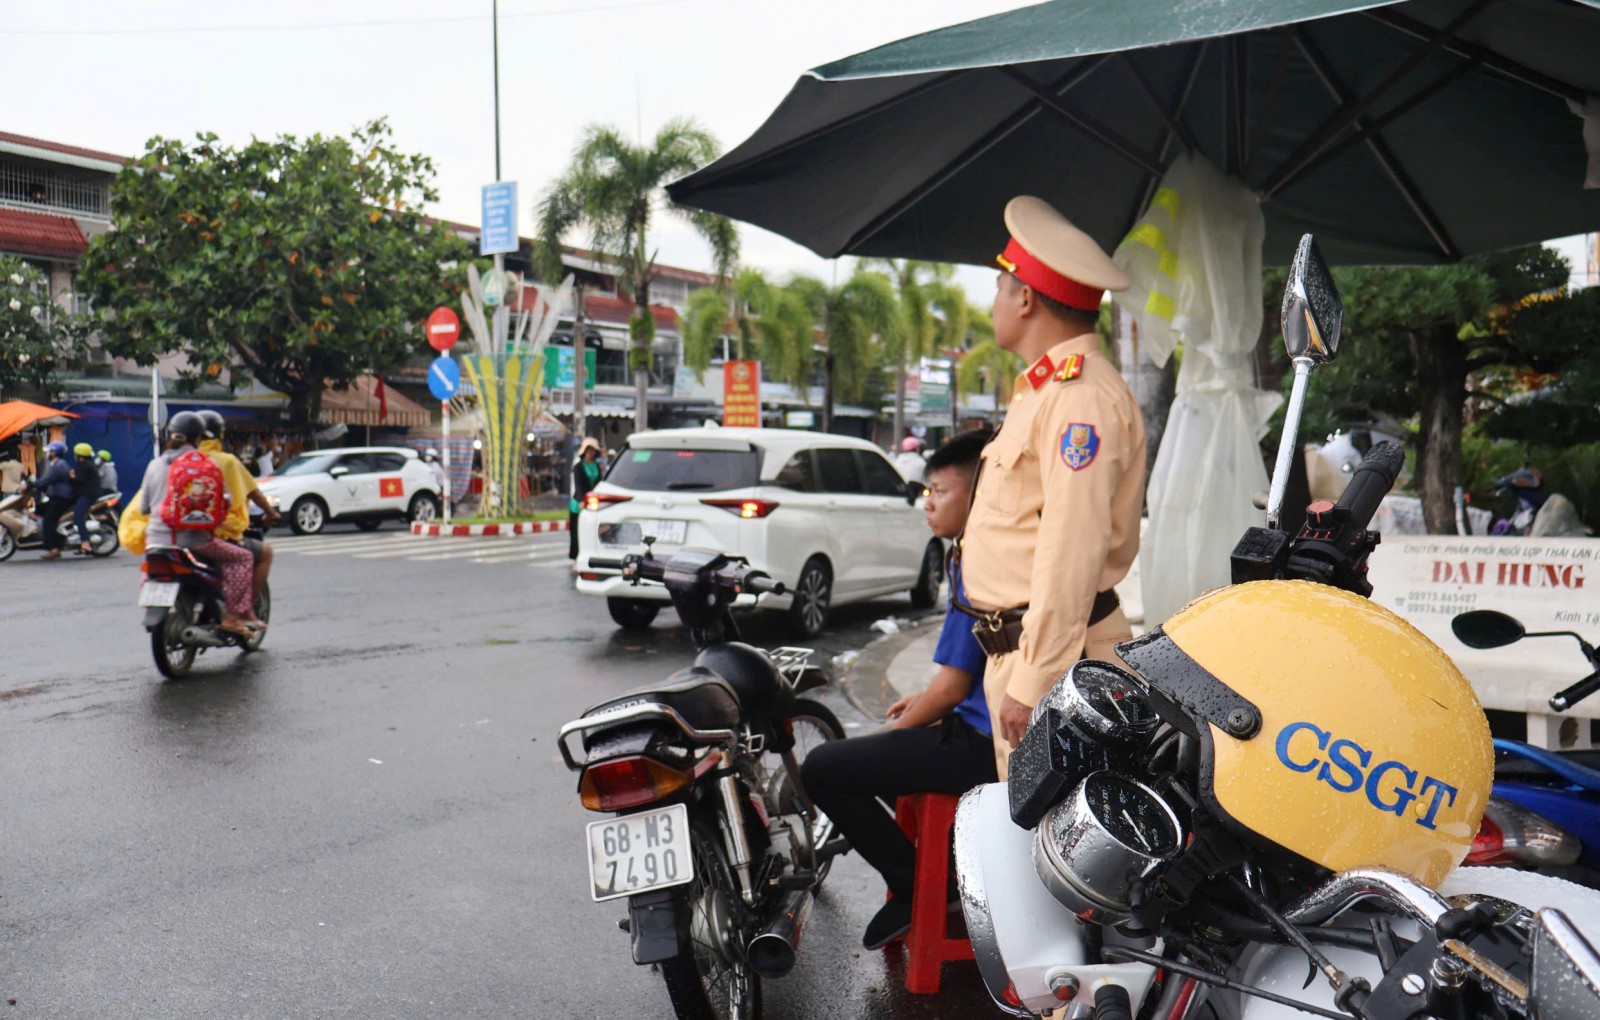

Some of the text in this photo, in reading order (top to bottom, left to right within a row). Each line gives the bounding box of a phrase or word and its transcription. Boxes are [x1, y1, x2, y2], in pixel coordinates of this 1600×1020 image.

[1571, 548, 1592, 559] LAN
[1554, 610, 1581, 622] Kinh
[1275, 721, 1458, 830] CSGT
[606, 848, 677, 893] 7490
